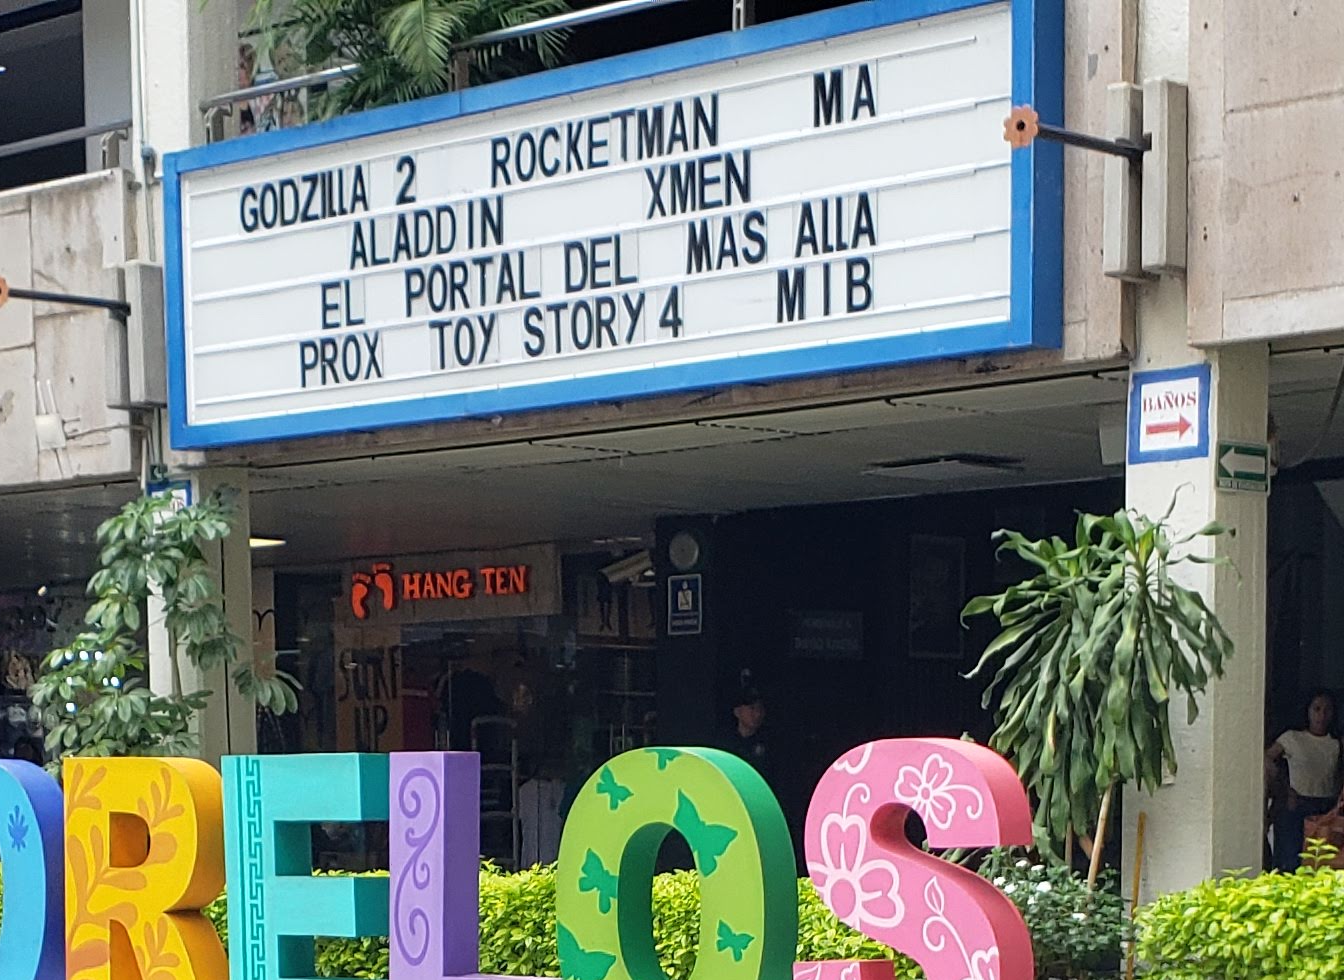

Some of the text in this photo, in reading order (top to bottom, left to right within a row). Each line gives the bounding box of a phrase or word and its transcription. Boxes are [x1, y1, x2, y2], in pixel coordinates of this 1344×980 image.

[239, 63, 877, 233] GODZILLA 2 ROCKETMAN MA
[349, 149, 752, 270] ALADDIN XMEN
[299, 256, 873, 389] PROX TOY STORY 4 MIB
[320, 191, 877, 330] EL PORTAL DEL MAS ALLA
[1142, 390, 1197, 413] BAÑOS
[401, 565, 527, 600] HANG TEN
